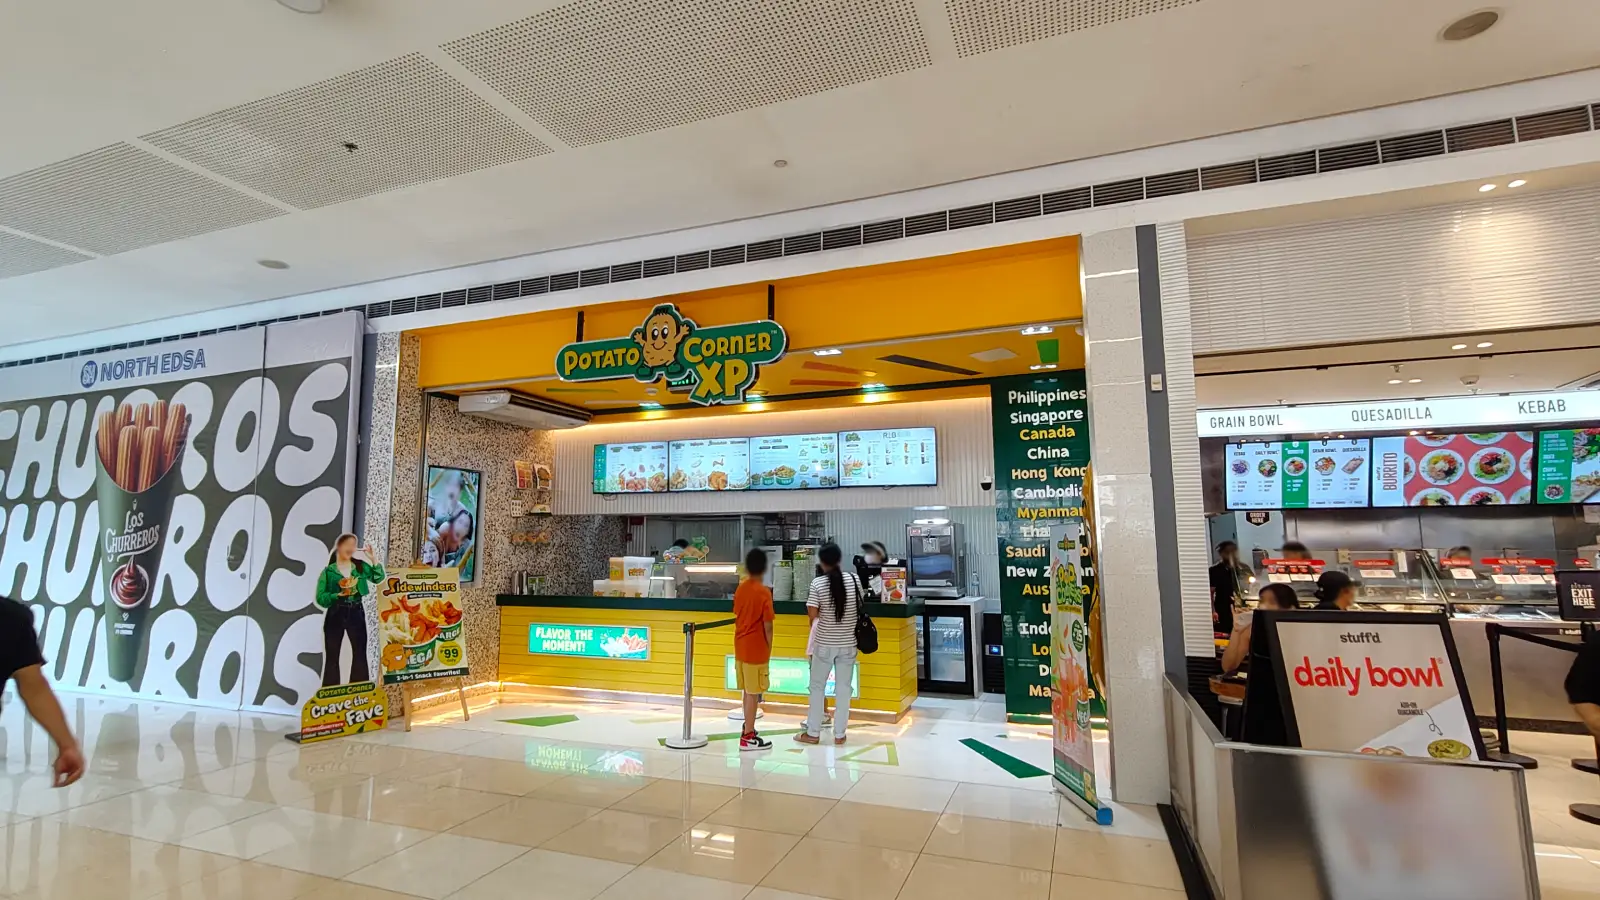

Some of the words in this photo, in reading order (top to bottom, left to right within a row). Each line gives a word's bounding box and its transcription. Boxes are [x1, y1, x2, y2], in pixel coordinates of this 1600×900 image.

[564, 348, 640, 375] POTATO
[683, 332, 772, 363] CORNER
[100, 355, 159, 382] NORTH
[160, 348, 206, 374] EDSA
[695, 358, 749, 398] XP
[1008, 389, 1087, 406] Philippines
[1518, 399, 1566, 414] KEBAB
[1010, 409, 1084, 425] Singapore
[1210, 416, 1245, 428] GRAIN
[1249, 414, 1283, 427] BOWL
[1351, 407, 1432, 422] QUESADILLA
[1020, 425, 1076, 441] Canada
[1027, 447, 1069, 459] China
[1011, 468, 1047, 481] Hong
[1382, 452, 1398, 490] BURRITO
[1005, 545, 1046, 558] Saudi
[1571, 588, 1593, 598] EXIT
[1572, 598, 1595, 606] HERE
[536, 627, 571, 640] FLAVOR
[575, 629, 593, 640] THE
[1340, 632, 1381, 644] stuff'd
[542, 640, 585, 652] MOMENT!
[1294, 656, 1361, 696] daily
[311, 699, 352, 718] Crave
[353, 696, 369, 706] the
[346, 704, 384, 725] Fave
